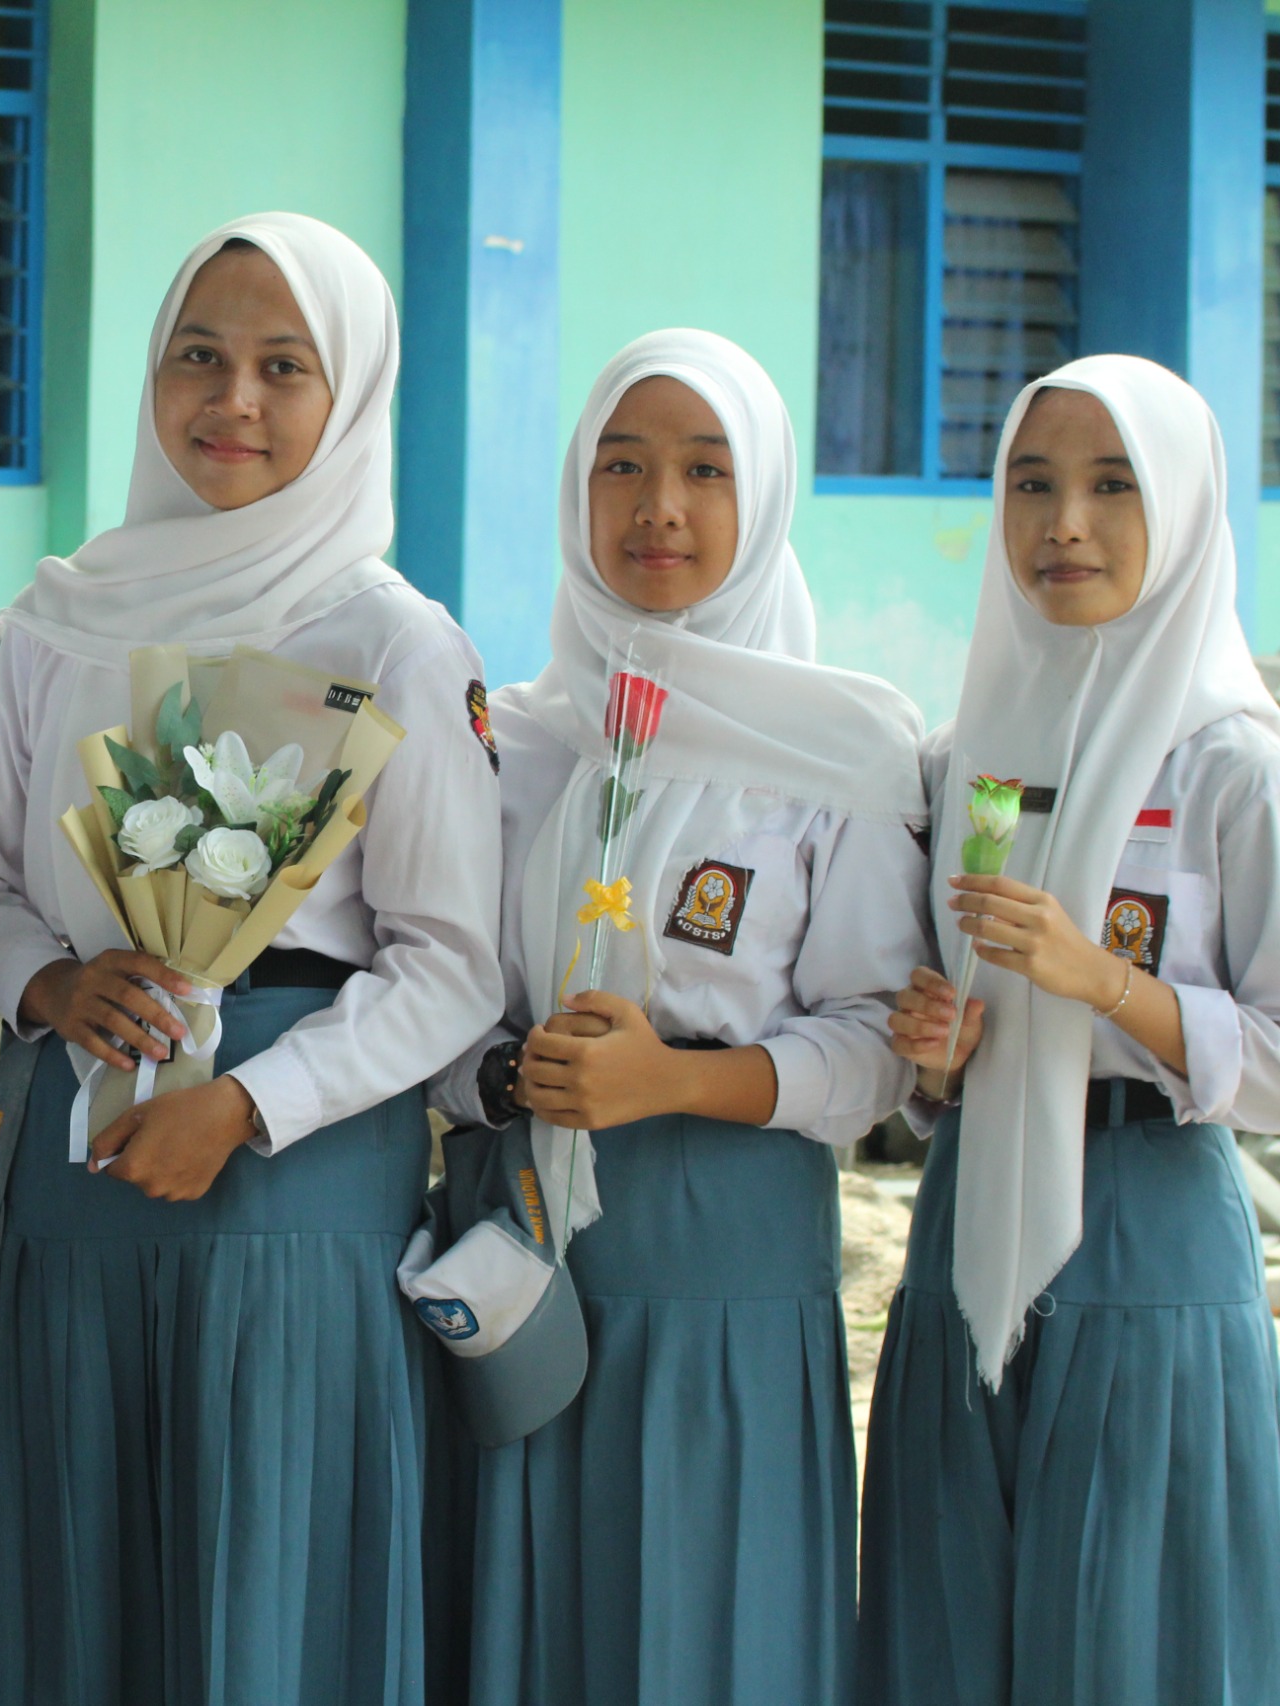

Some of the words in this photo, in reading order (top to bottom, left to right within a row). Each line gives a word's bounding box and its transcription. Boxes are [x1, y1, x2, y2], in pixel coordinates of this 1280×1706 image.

[682, 921, 721, 940] OSIS
[519, 1168, 539, 1207] MADIUN
[527, 1207, 541, 1215] 2
